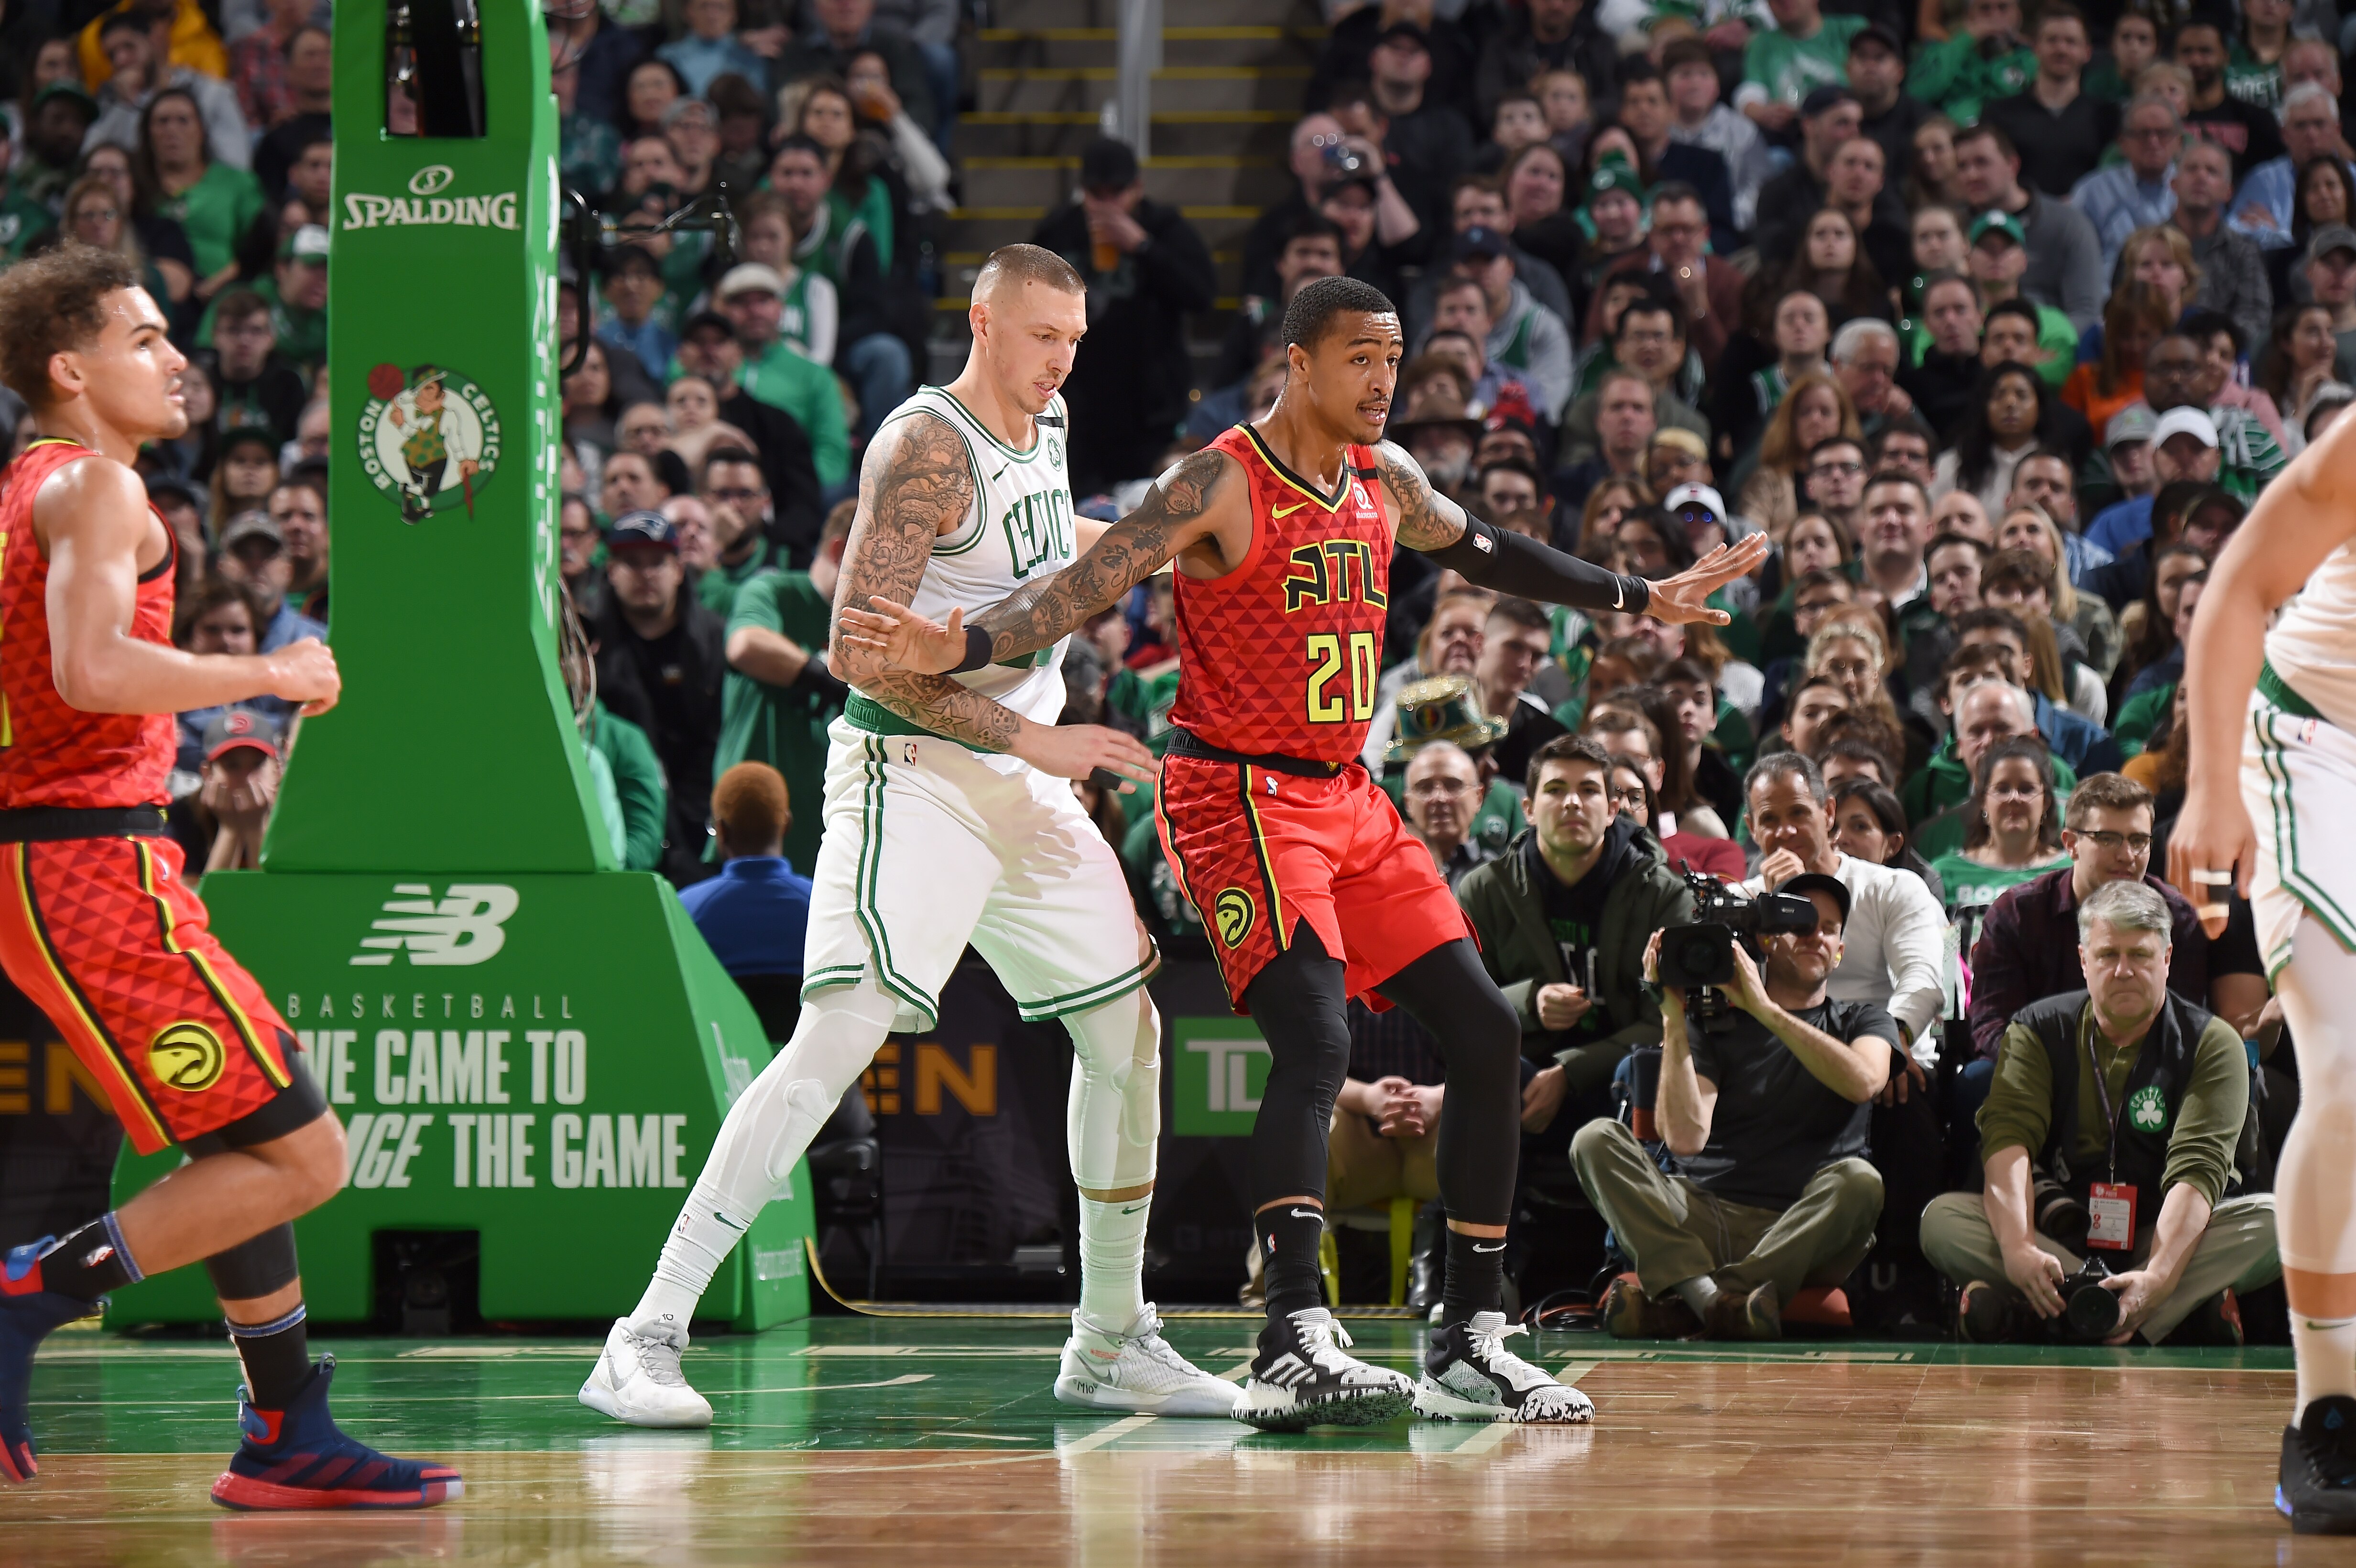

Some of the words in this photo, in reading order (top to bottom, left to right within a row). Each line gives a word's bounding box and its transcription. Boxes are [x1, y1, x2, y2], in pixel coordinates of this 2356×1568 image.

[343, 192, 518, 230] SPALDING
[359, 399, 391, 491] BOSTON
[461, 382, 501, 473] CELTICS
[1281, 539, 1387, 613] ATL
[1306, 631, 1376, 724] 20
[287, 994, 573, 1019] BASKETBALL
[374, 1029, 510, 1104] CAME
[524, 1029, 587, 1104] TO
[2131, 1086, 2165, 1108] CELTICS
[447, 1114, 535, 1188] THE
[551, 1112, 687, 1189] GAME
